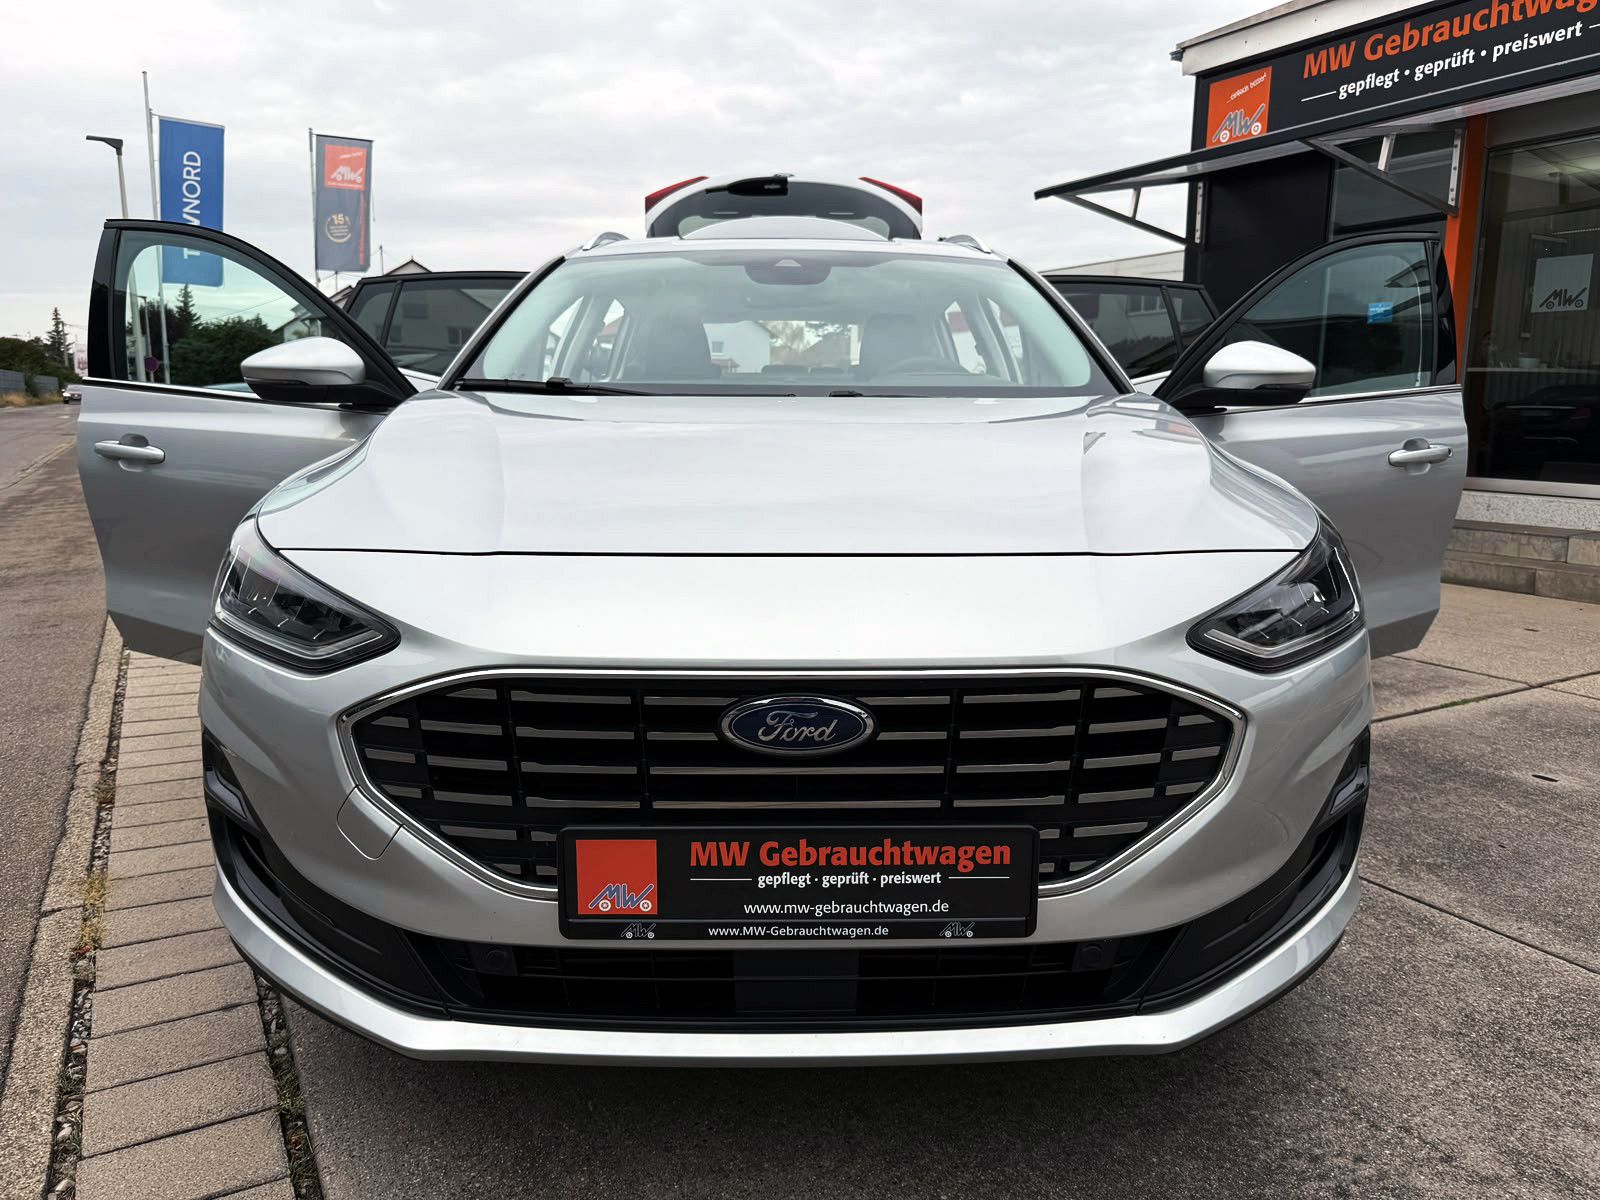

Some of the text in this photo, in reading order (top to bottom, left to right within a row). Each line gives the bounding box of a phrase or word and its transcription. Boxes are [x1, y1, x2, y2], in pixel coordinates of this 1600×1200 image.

[1303, 40, 1356, 79] MW
[1338, 20, 1583, 100] gepflegt geprüft preiswert
[757, 710, 838, 742] Ford
[690, 838, 1011, 873] MW Gebrauchtwagen
[757, 871, 942, 888] gepflegt geprüft preiswert
[744, 899, 950, 916] www.mw-gebrauchtwagen.de
[708, 924, 889, 939] www.MW-Gebrauchtwagen.de
